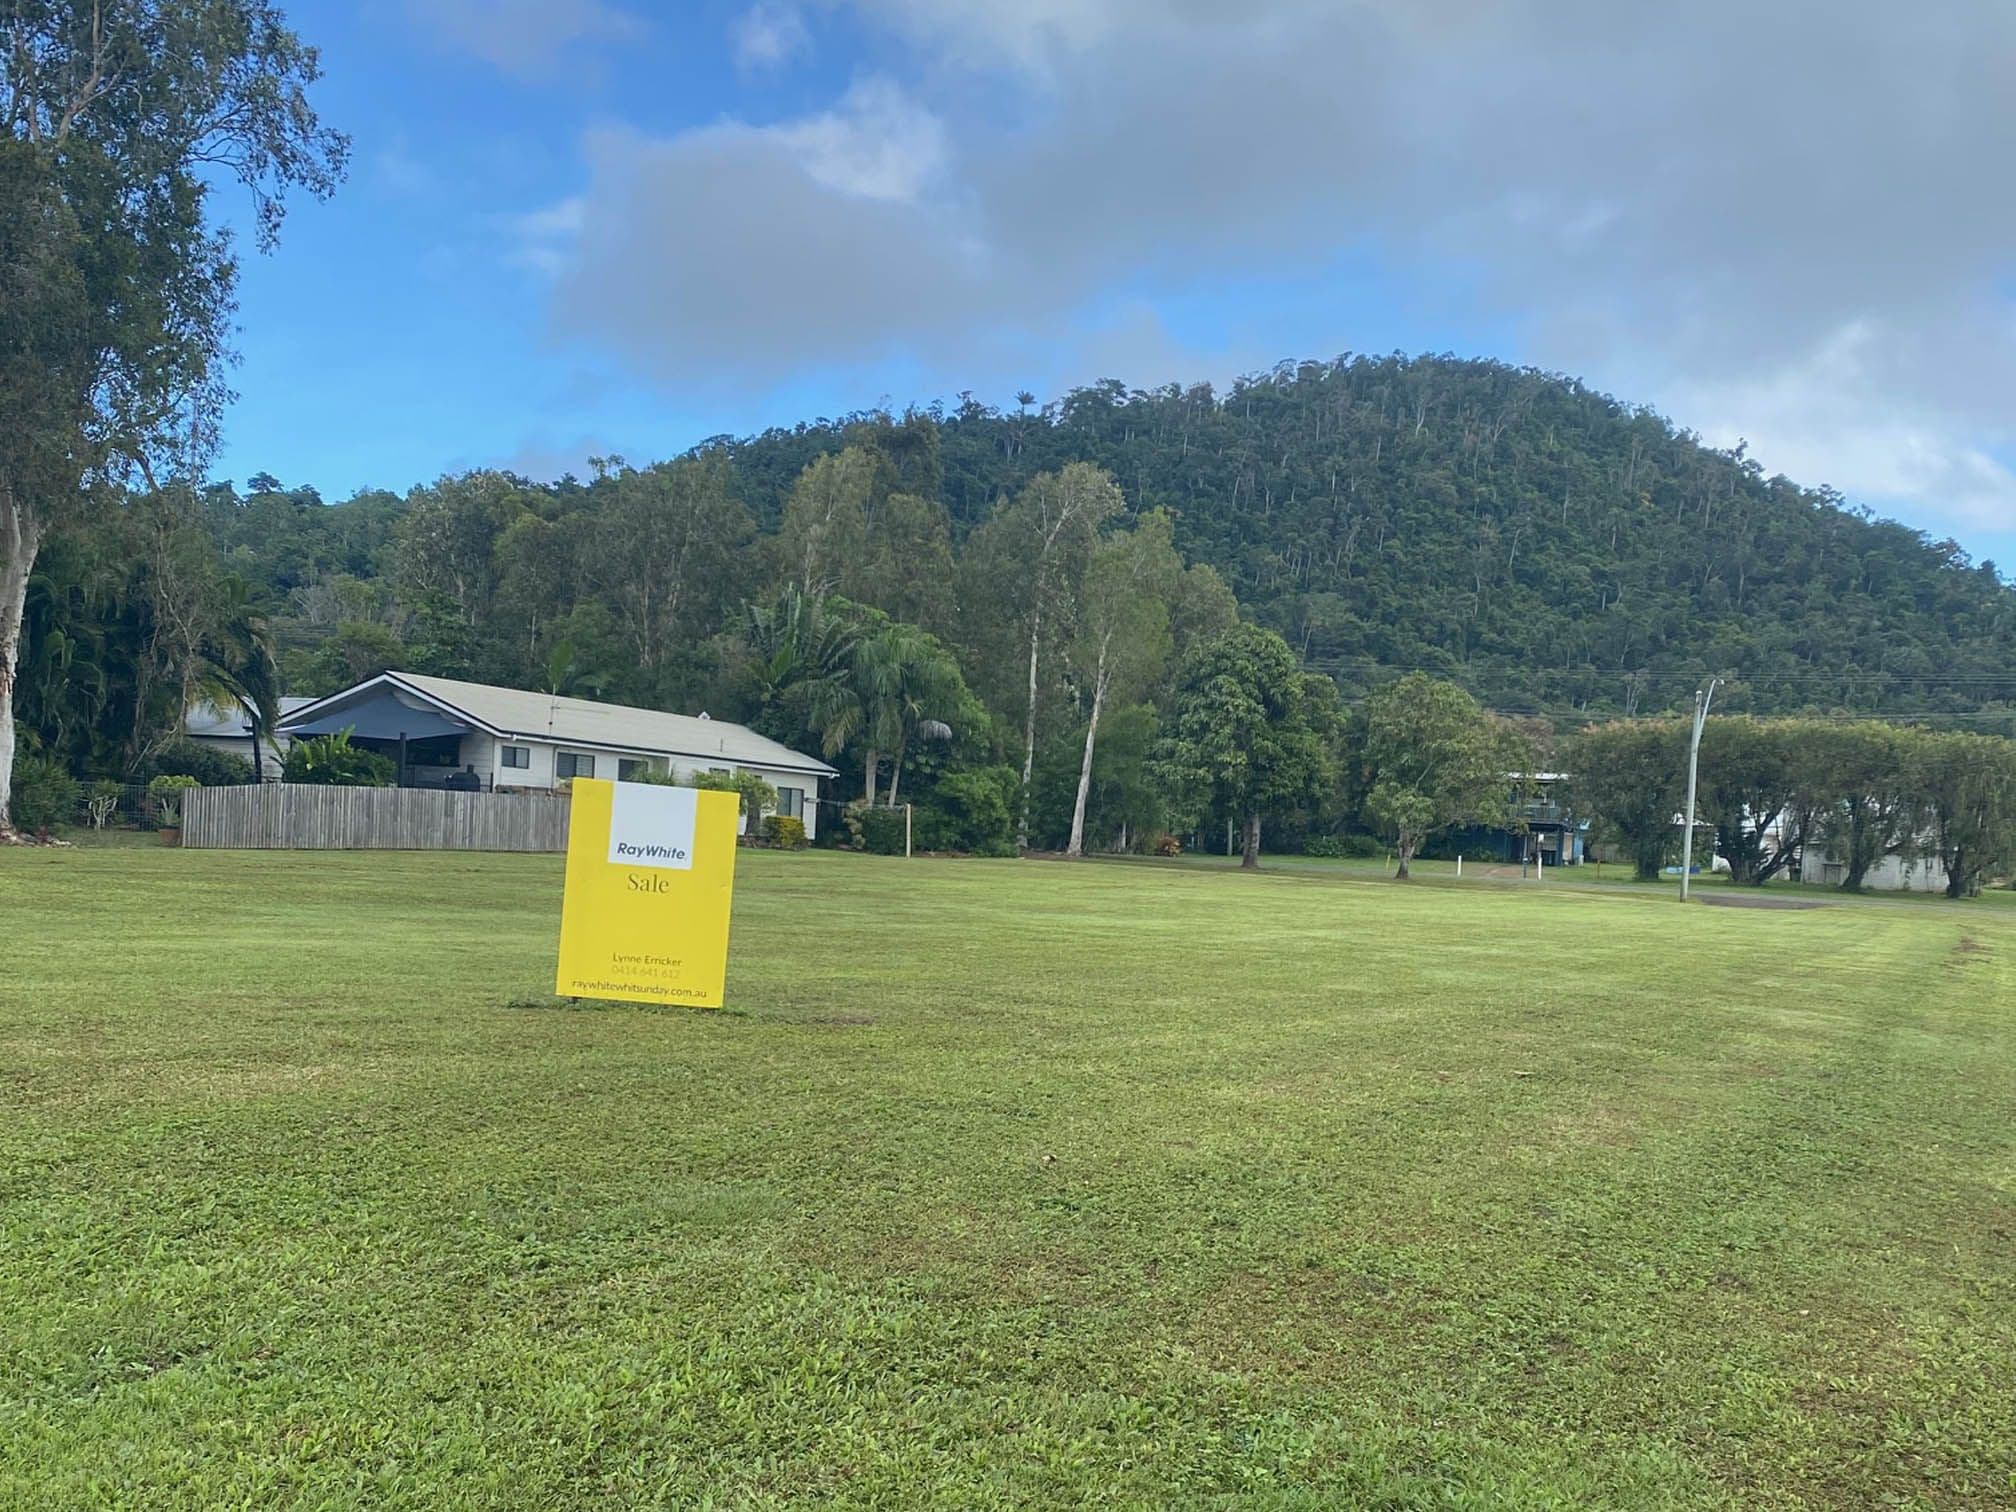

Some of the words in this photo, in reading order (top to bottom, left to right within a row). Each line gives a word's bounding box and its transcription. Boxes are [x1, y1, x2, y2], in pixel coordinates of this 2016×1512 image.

[627, 873, 670, 894] Sale
[613, 953, 641, 966] Lynne
[572, 979, 707, 998] raywhitewhitsunday.com.au
